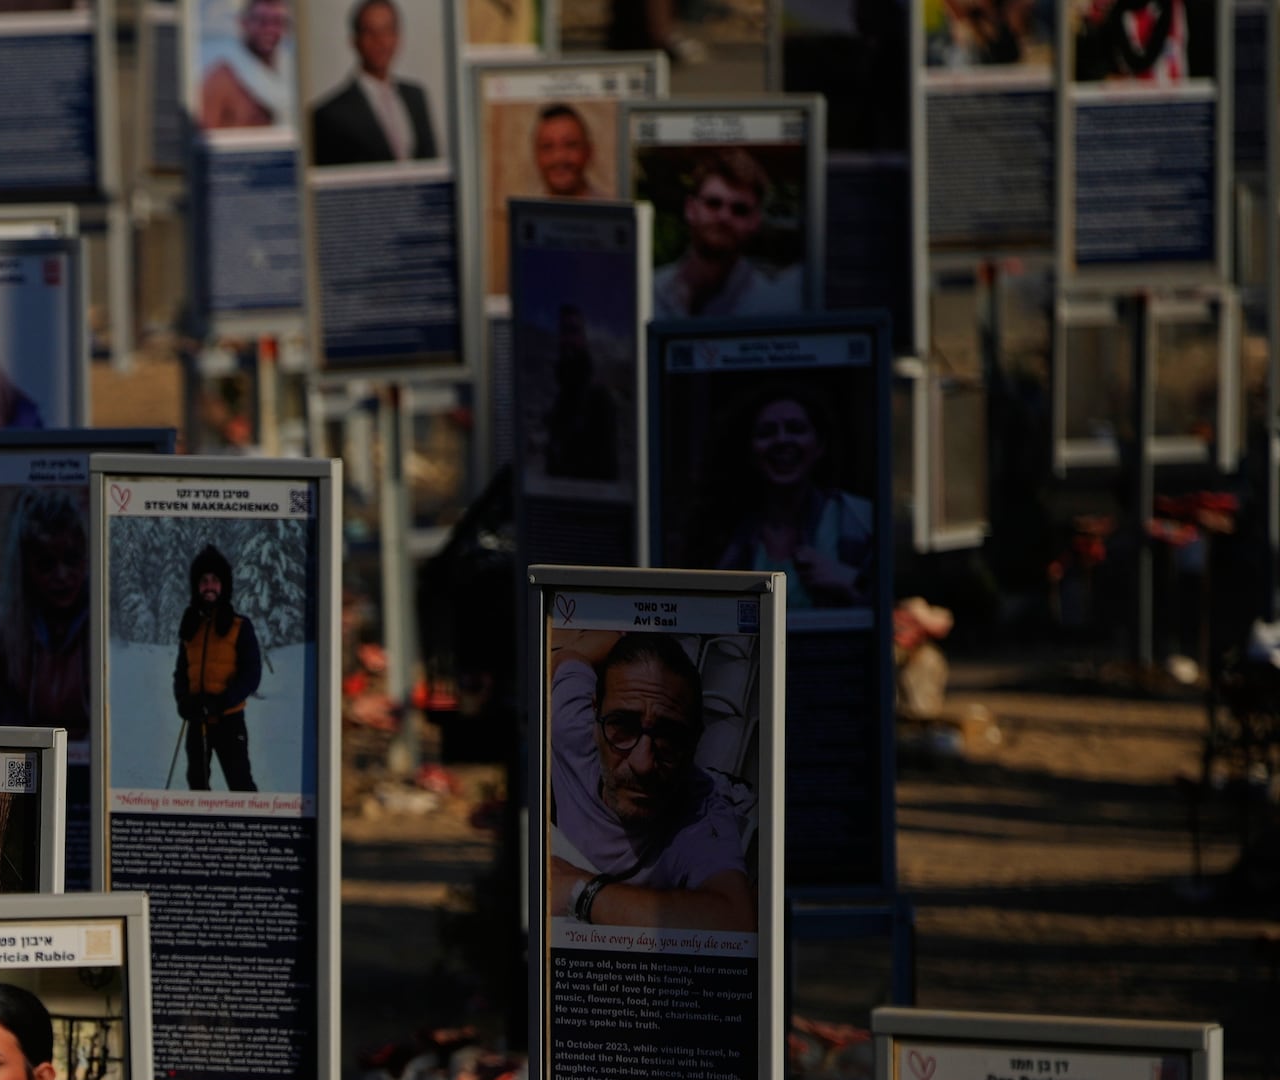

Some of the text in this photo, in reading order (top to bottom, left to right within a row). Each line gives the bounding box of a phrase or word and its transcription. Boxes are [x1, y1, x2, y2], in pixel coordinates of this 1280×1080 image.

[144, 501, 279, 511] STEVEN MAKRACHENKO
[660, 603, 677, 612] אבי
[633, 615, 677, 626] Avi Sasi
[20, 936, 52, 947] איבון
[565, 930, 748, 950] “You live every day, you only die once.”
[34, 952, 75, 961] Rubio
[554, 957, 566, 966] 65
[568, 960, 594, 968] years
[596, 960, 613, 969] old,
[615, 960, 636, 969] born
[639, 962, 648, 970] in
[650, 962, 691, 974] Netanya,
[693, 965, 714, 973] later
